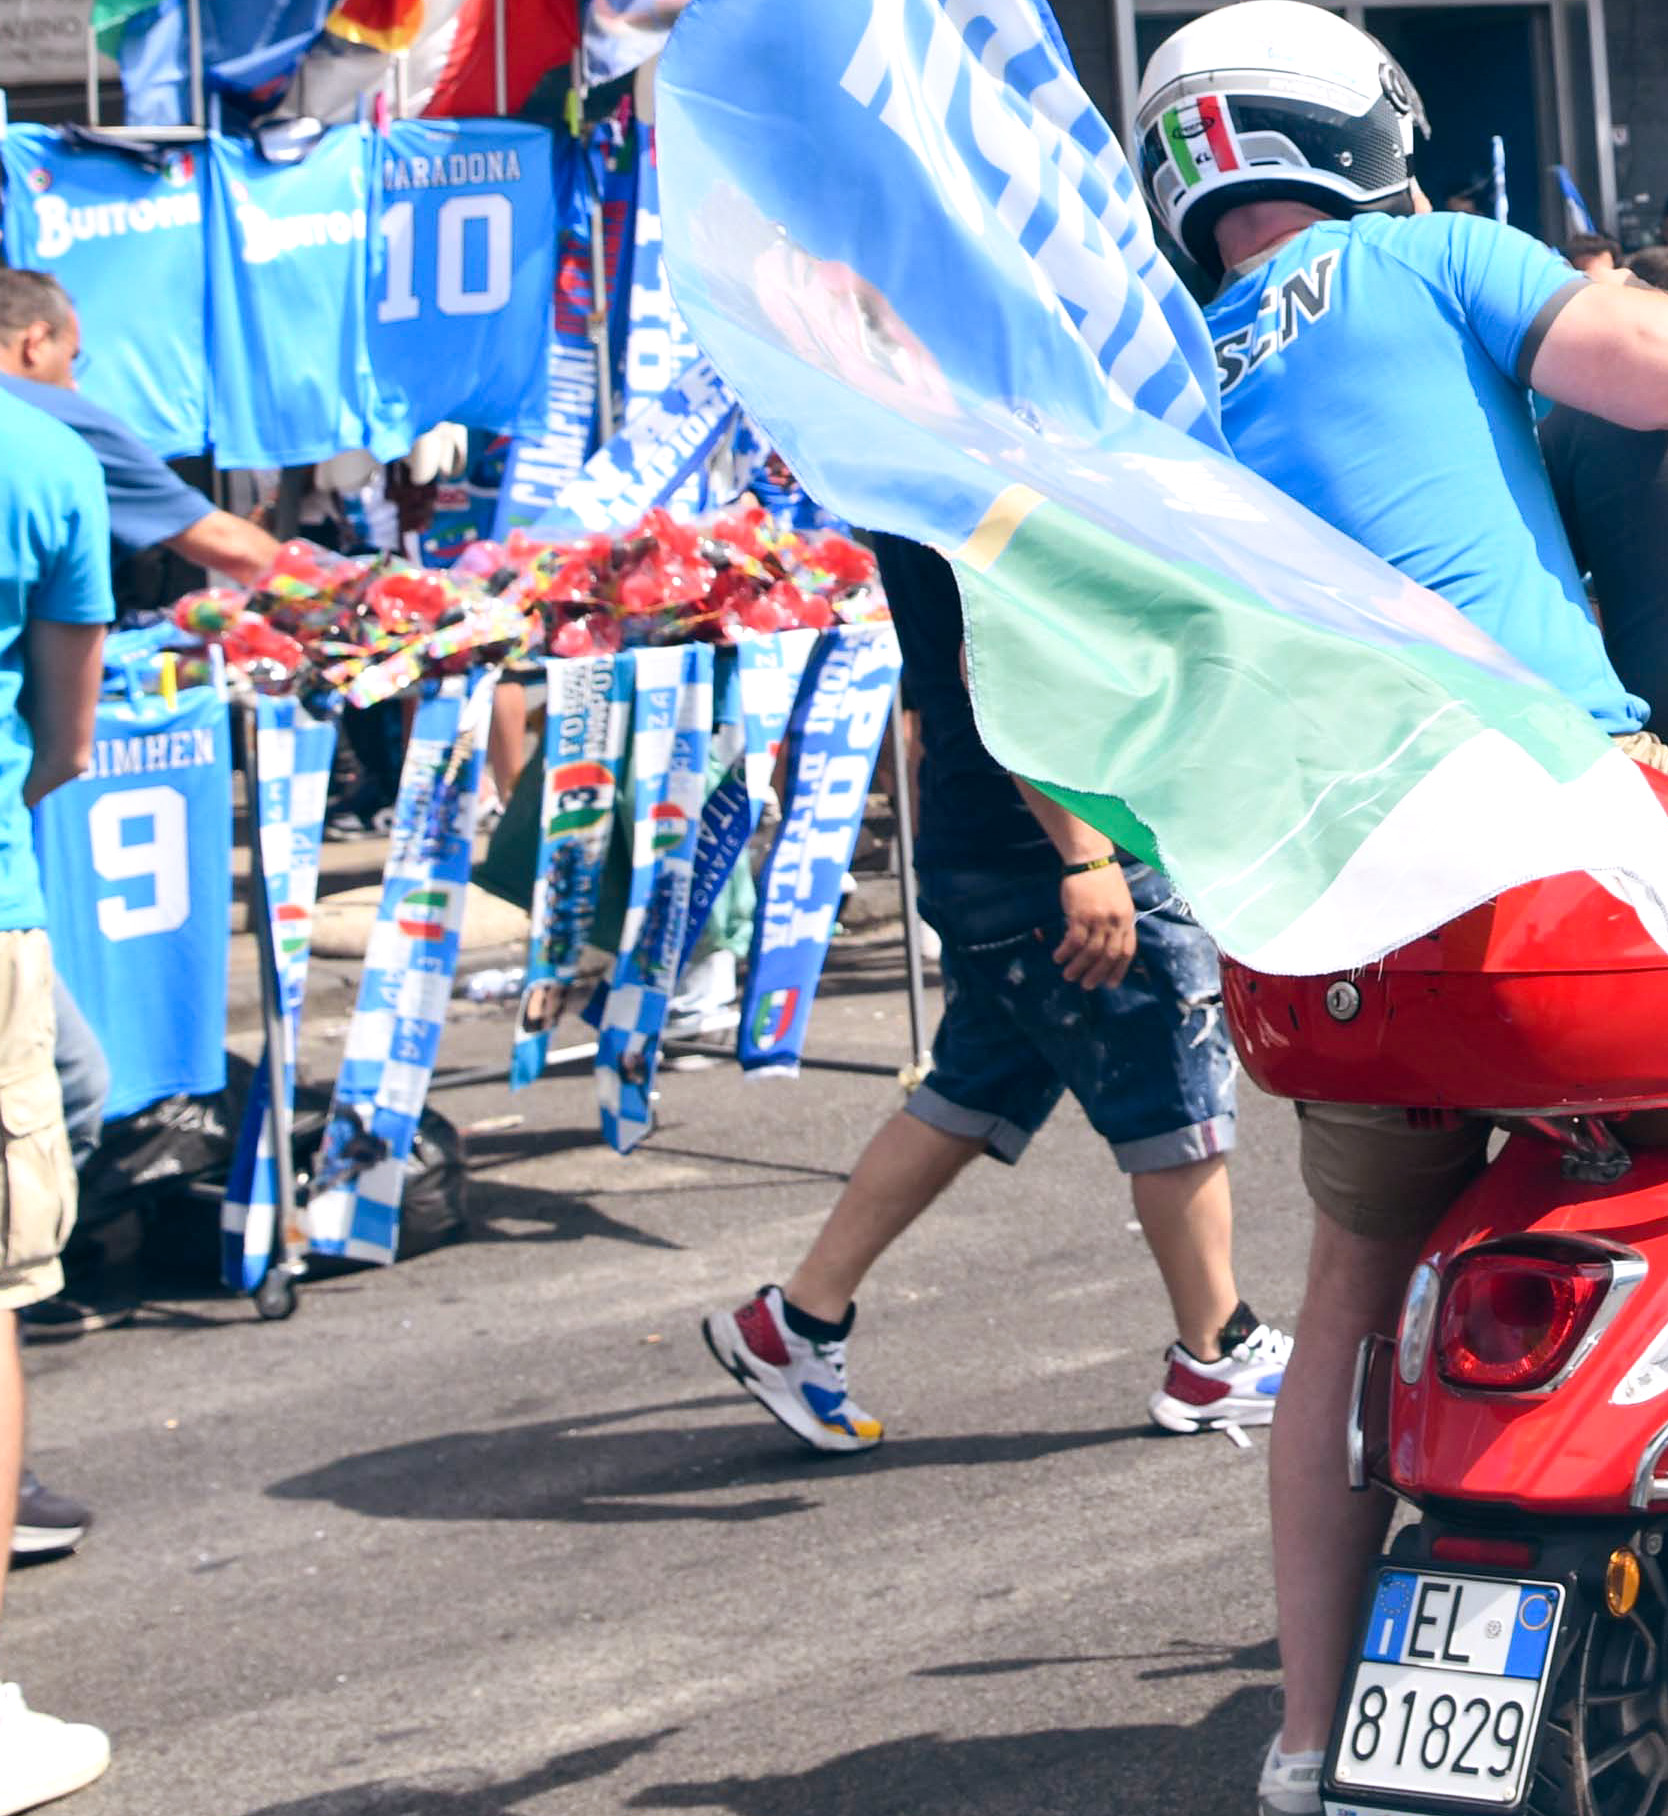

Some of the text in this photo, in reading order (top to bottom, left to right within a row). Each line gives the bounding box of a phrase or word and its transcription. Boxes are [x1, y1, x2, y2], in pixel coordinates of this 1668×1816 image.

[378, 192, 513, 323] 10
[89, 784, 190, 942] 9
[1408, 1582, 1469, 1663] EL
[1351, 1685, 1524, 1777] 81829
